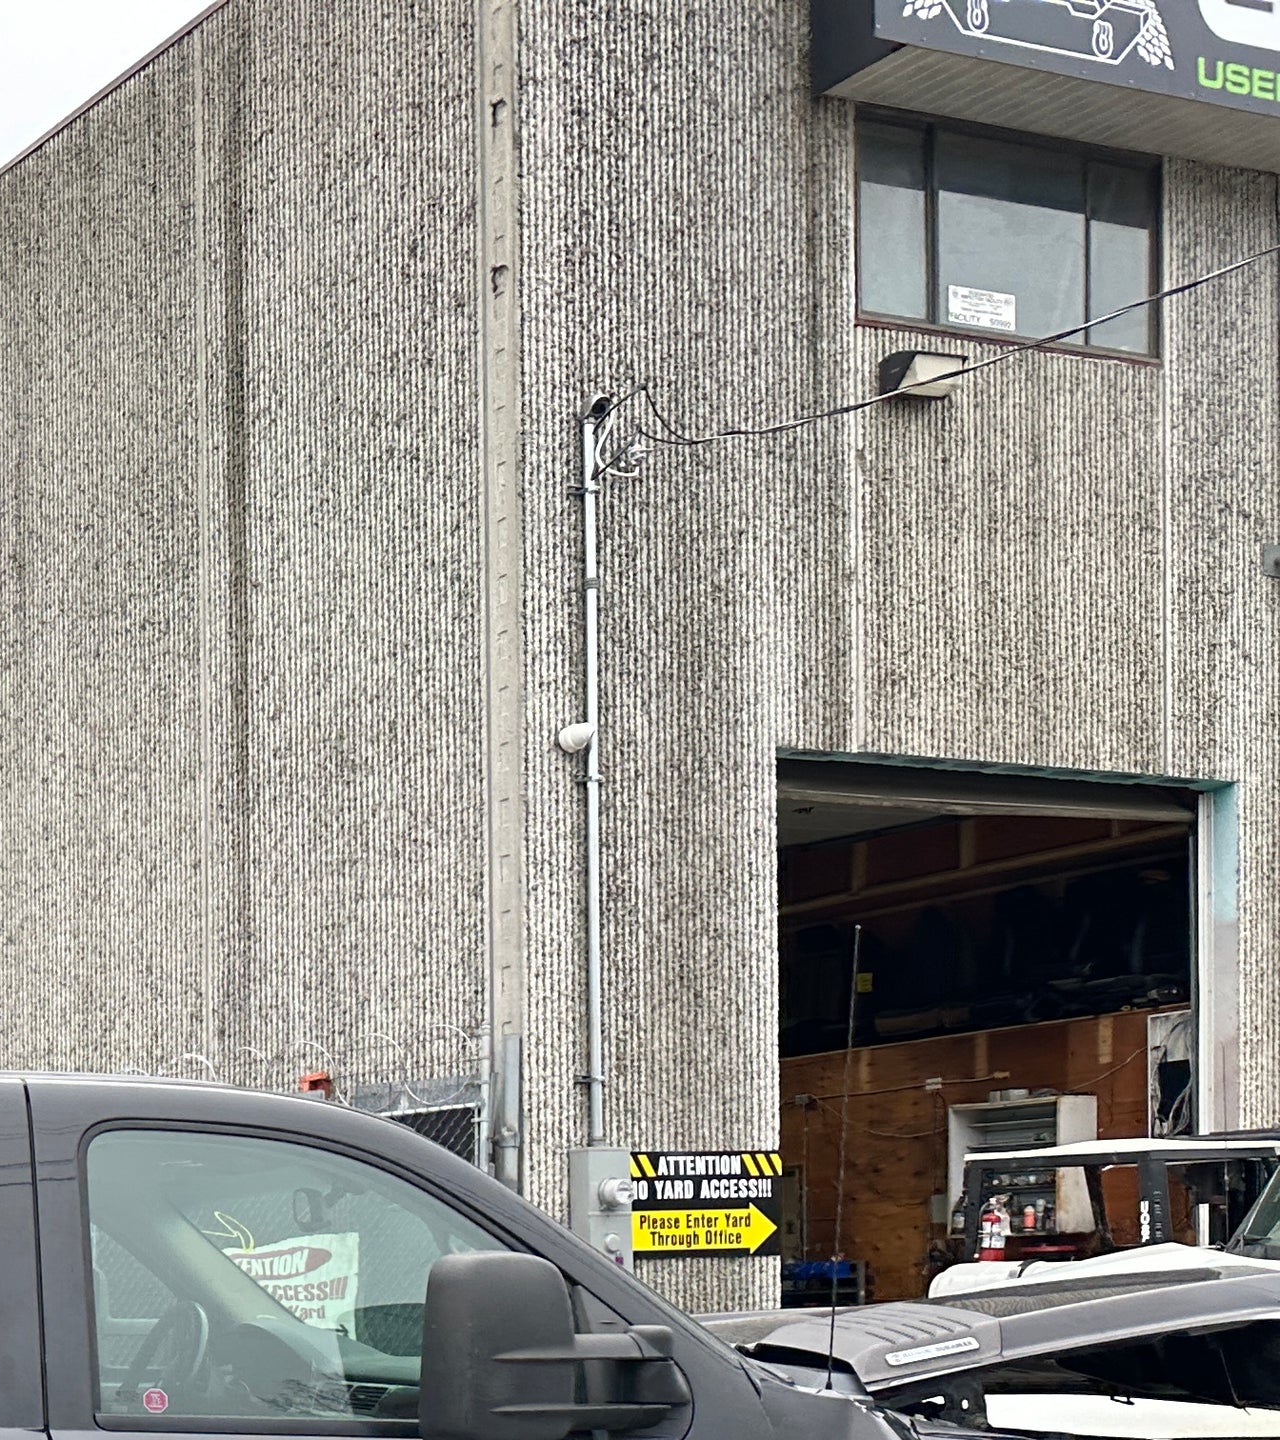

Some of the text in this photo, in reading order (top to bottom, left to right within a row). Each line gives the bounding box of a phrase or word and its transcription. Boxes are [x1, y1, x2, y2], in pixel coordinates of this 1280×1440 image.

[1197, 56, 1280, 103] USE
[657, 1155, 742, 1176] ATTENTION
[654, 1180, 694, 1200] YARD
[700, 1178, 772, 1199] ACCESS!!!
[640, 1213, 751, 1230] Please Enter Yard
[650, 1230, 742, 1248] Through Office
[234, 1248, 309, 1277] ENTION
